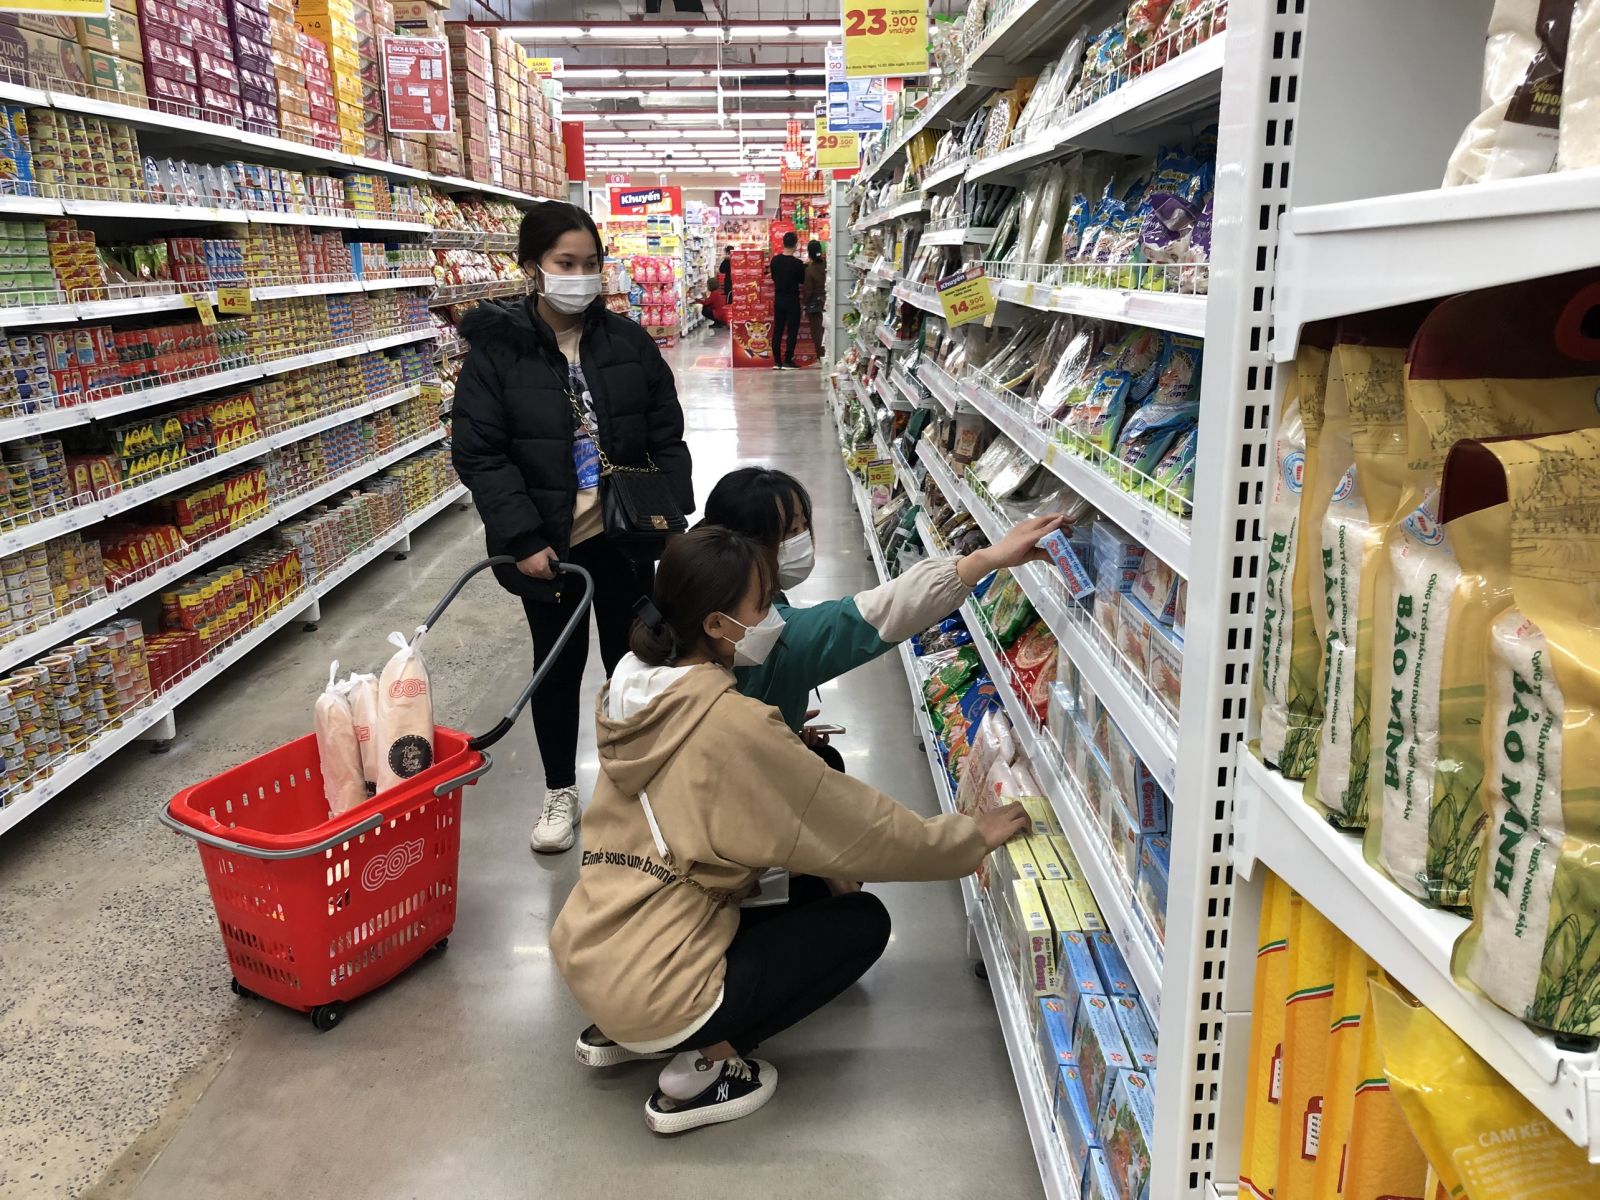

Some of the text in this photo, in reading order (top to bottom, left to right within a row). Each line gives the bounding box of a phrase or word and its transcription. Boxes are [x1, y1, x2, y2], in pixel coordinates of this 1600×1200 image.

[846, 8, 887, 36] 23
[0, 40, 25, 59] UNG
[816, 135, 838, 149] 29
[621, 190, 661, 205] Khuyến
[950, 300, 969, 316] 14
[1267, 532, 1287, 599] BẢO
[1322, 547, 1338, 620] BẢO
[1424, 573, 1438, 600] CÔNG
[1421, 601, 1430, 616] TY
[1412, 662, 1422, 688] KINH
[1531, 650, 1543, 682] CÔNG
[1384, 593, 1417, 791] BẢO MINH
[1409, 688, 1419, 724] DOANH
[1407, 745, 1417, 768] BIẾN
[1536, 751, 1547, 782] KINH
[1405, 769, 1415, 799] NÔNG
[1493, 668, 1540, 898] BẢO MINH
[1403, 799, 1413, 821] SẢN
[1531, 784, 1543, 828] DOANH
[361, 837, 425, 892] GO!
[605, 851, 626, 866] sous
[642, 856, 677, 884] bonne
[1527, 848, 1541, 877] BIẾN
[1519, 877, 1535, 912] NÔNG
[1514, 912, 1528, 939] SẢN
[1478, 1117, 1551, 1148] CAM KẾT
